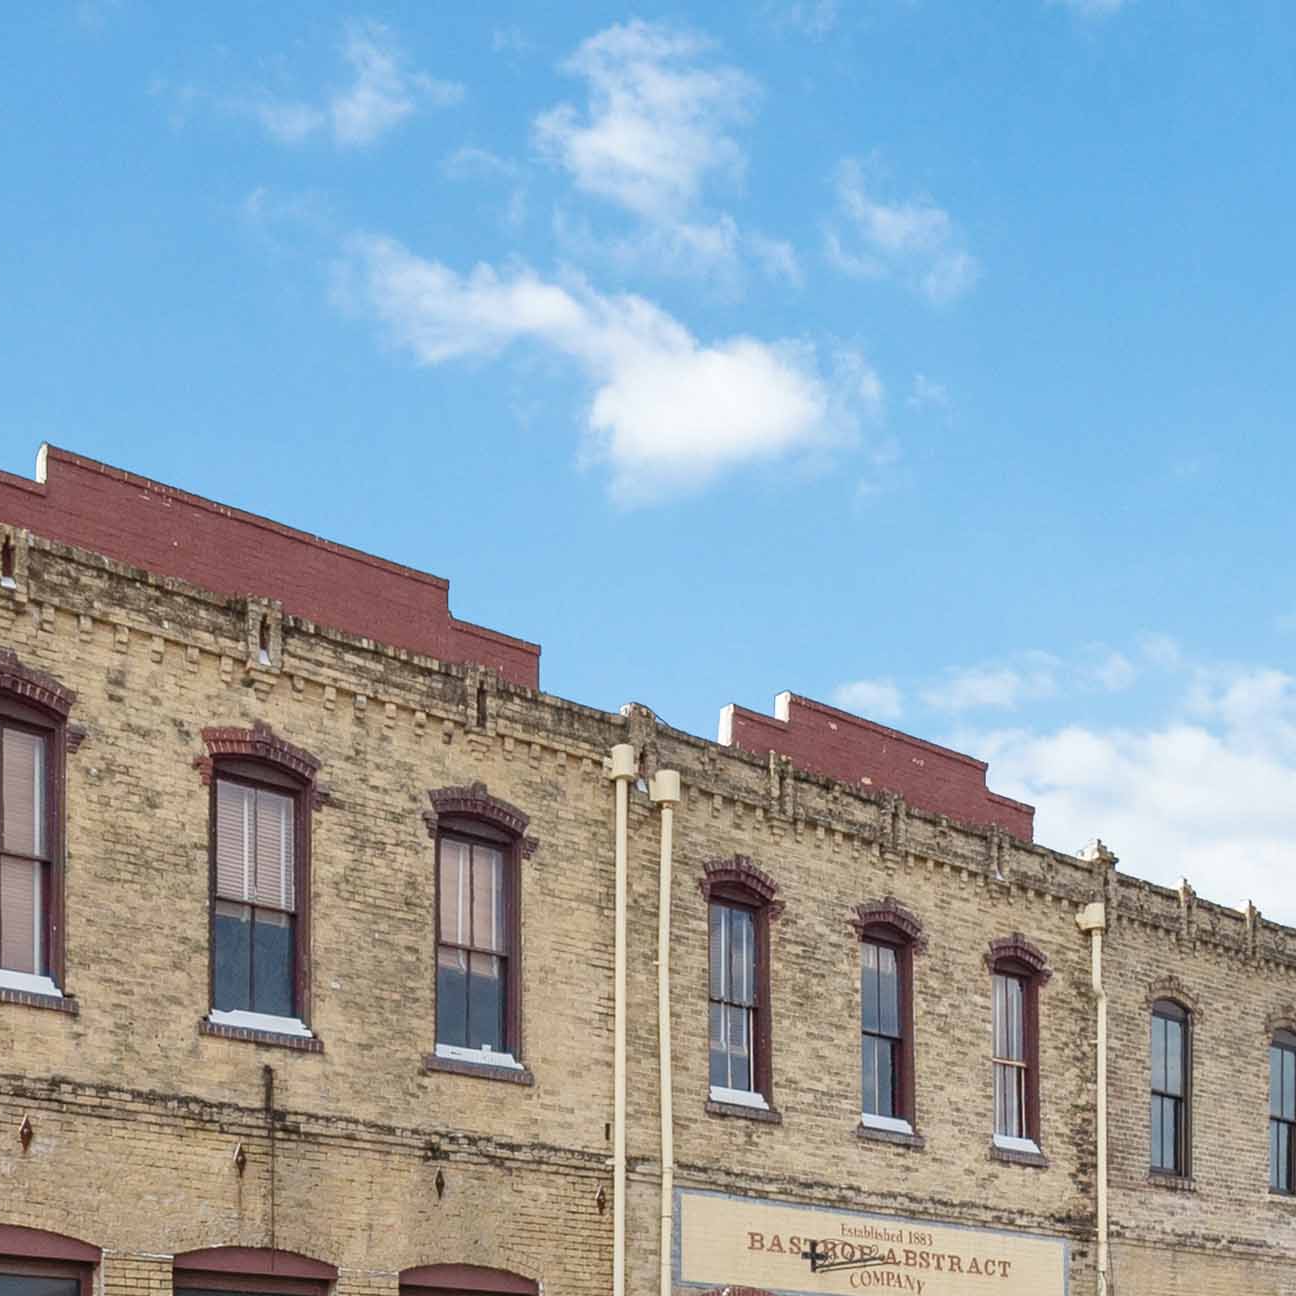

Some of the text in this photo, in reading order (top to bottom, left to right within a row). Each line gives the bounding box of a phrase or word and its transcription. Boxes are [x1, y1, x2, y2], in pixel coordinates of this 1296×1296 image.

[840, 1223, 933, 1247] Established 1883
[880, 1247, 1011, 1278] ABSTRACT
[849, 1270, 926, 1295] COMPANY
